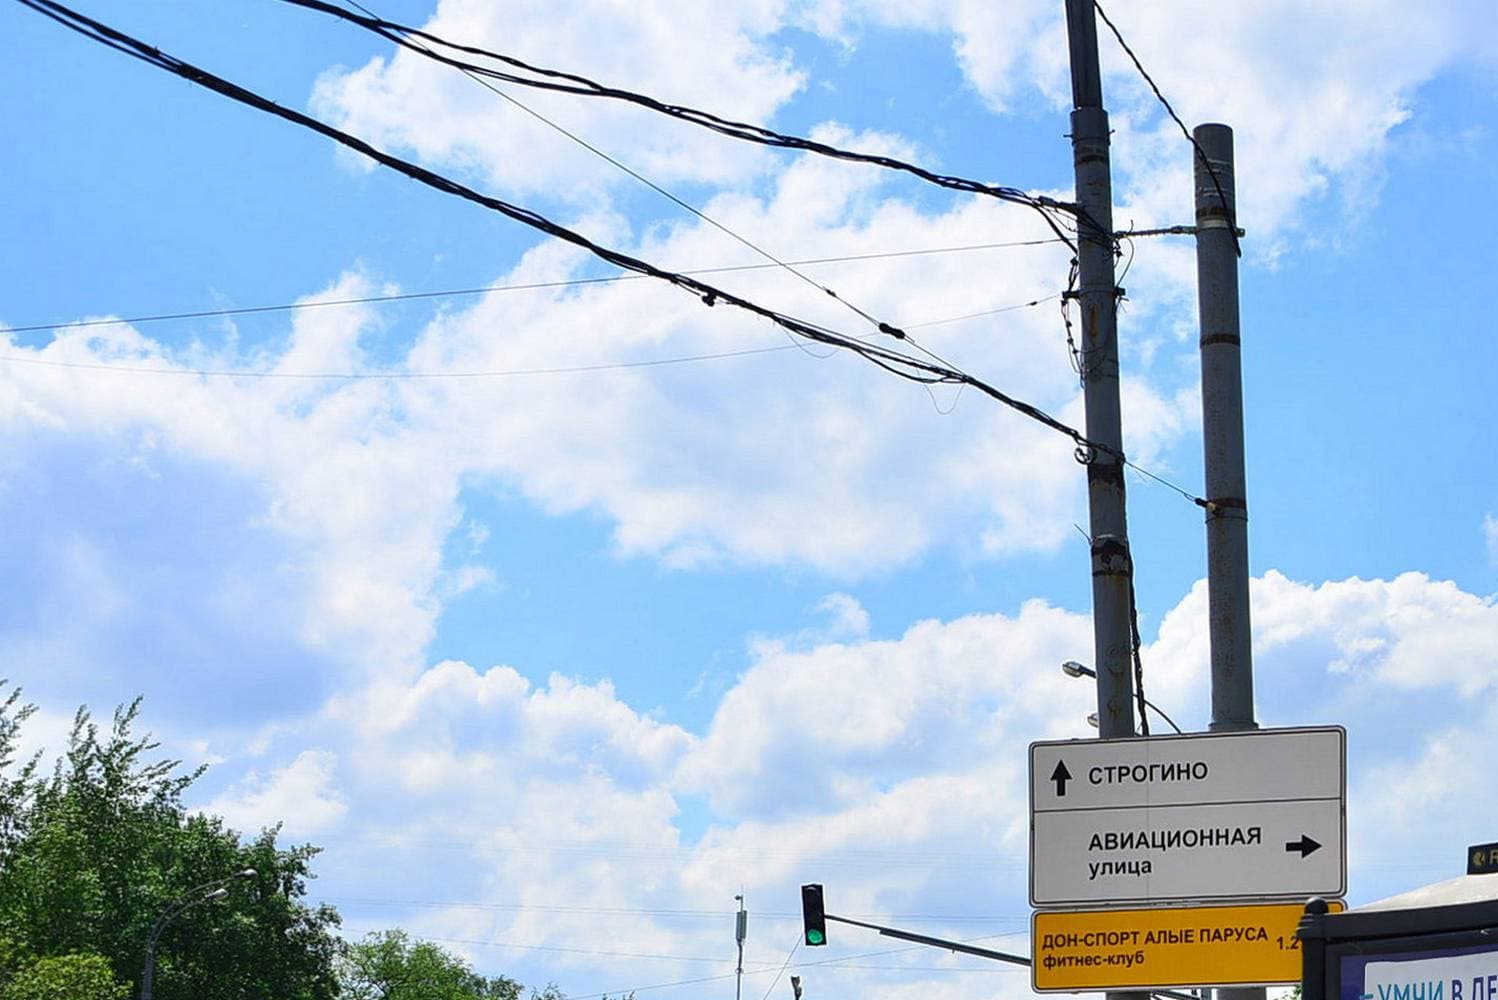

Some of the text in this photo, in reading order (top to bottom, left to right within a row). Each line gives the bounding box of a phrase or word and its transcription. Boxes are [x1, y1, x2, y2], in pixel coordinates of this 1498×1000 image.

[1088, 761, 1209, 785] СТРОГИНО
[1088, 826, 1262, 852] АВИАЦИОННАЯ
[1088, 859, 1153, 881] улица
[1041, 930, 1141, 951] ДОН-СПОРТ
[1144, 928, 1195, 945] АЛЫЕ
[1199, 926, 1269, 944] ПАРУСА
[1041, 950, 1146, 970] фитнес-клуб
